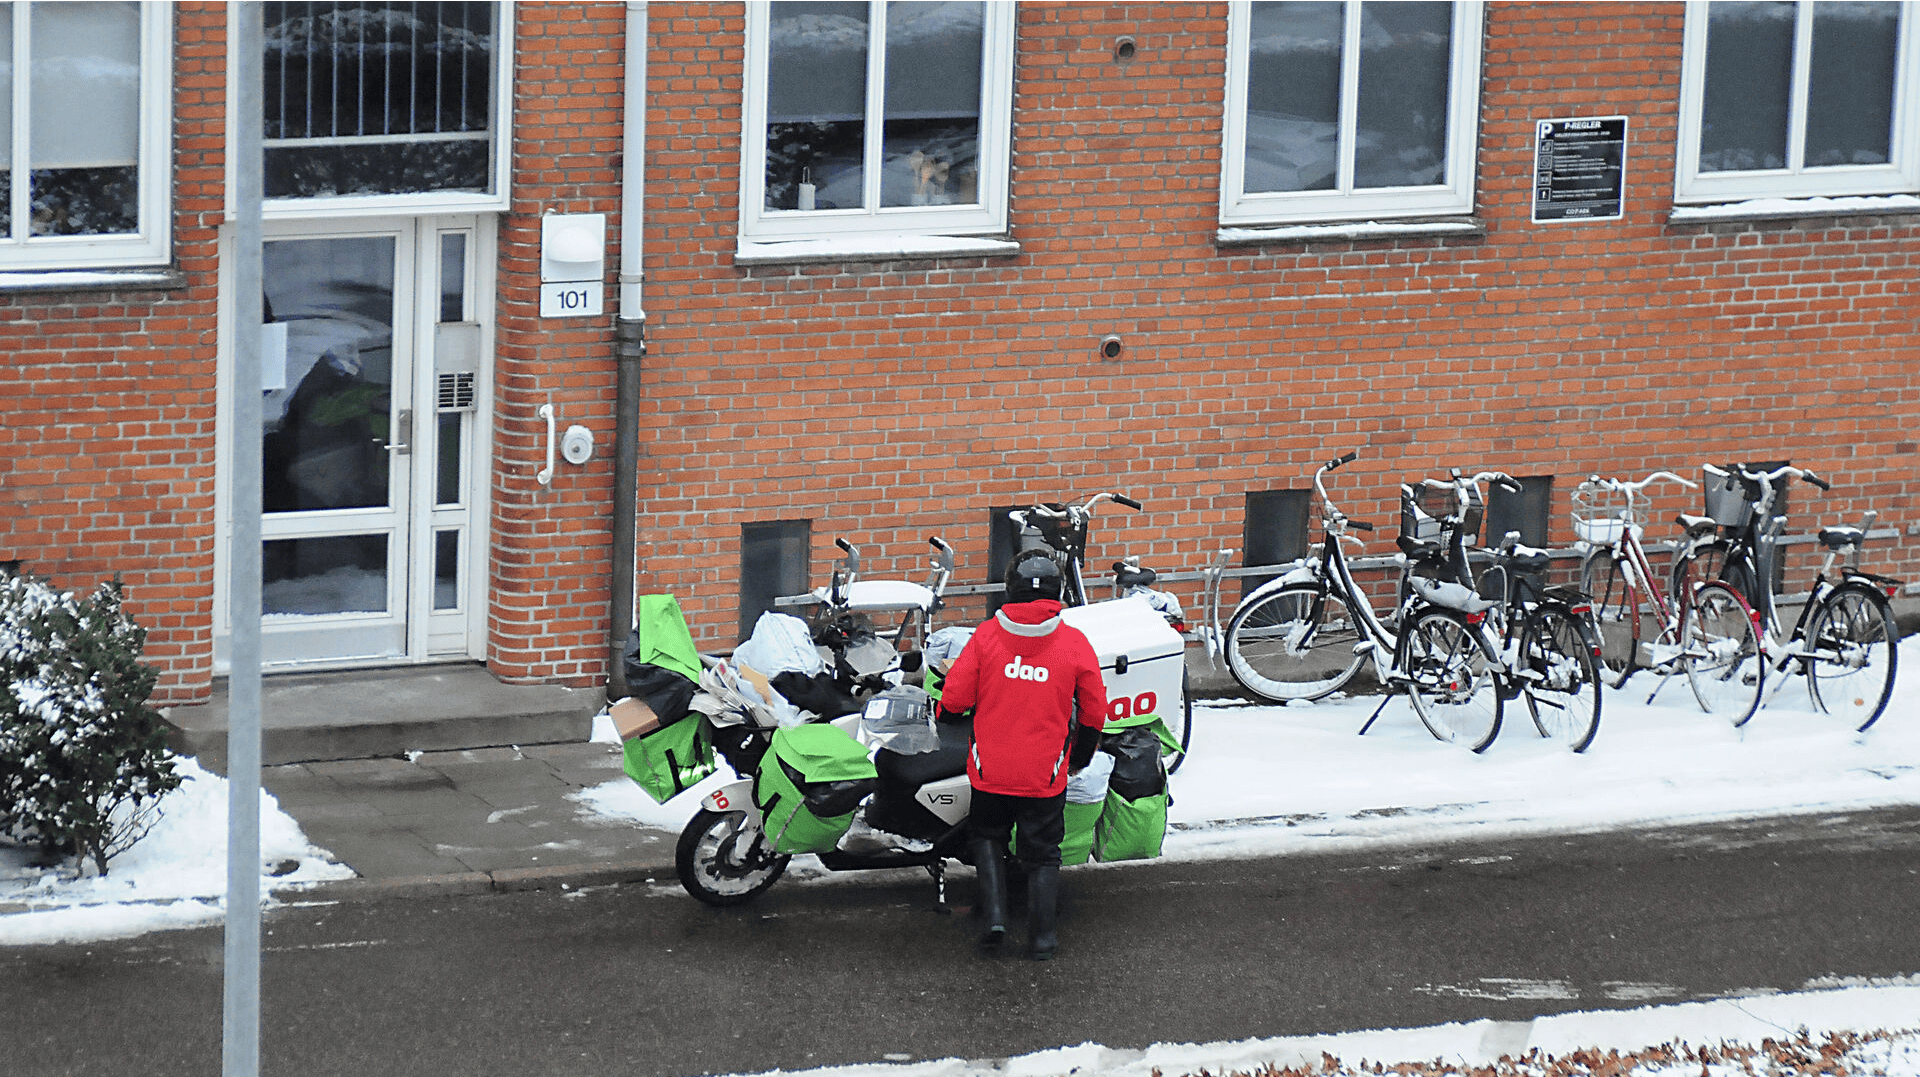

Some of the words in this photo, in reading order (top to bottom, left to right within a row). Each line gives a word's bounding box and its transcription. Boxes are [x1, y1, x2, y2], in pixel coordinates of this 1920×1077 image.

[1541, 123, 1553, 139] P
[557, 290, 587, 309] 101
[1004, 655, 1049, 682] dao
[1105, 691, 1157, 722] ao
